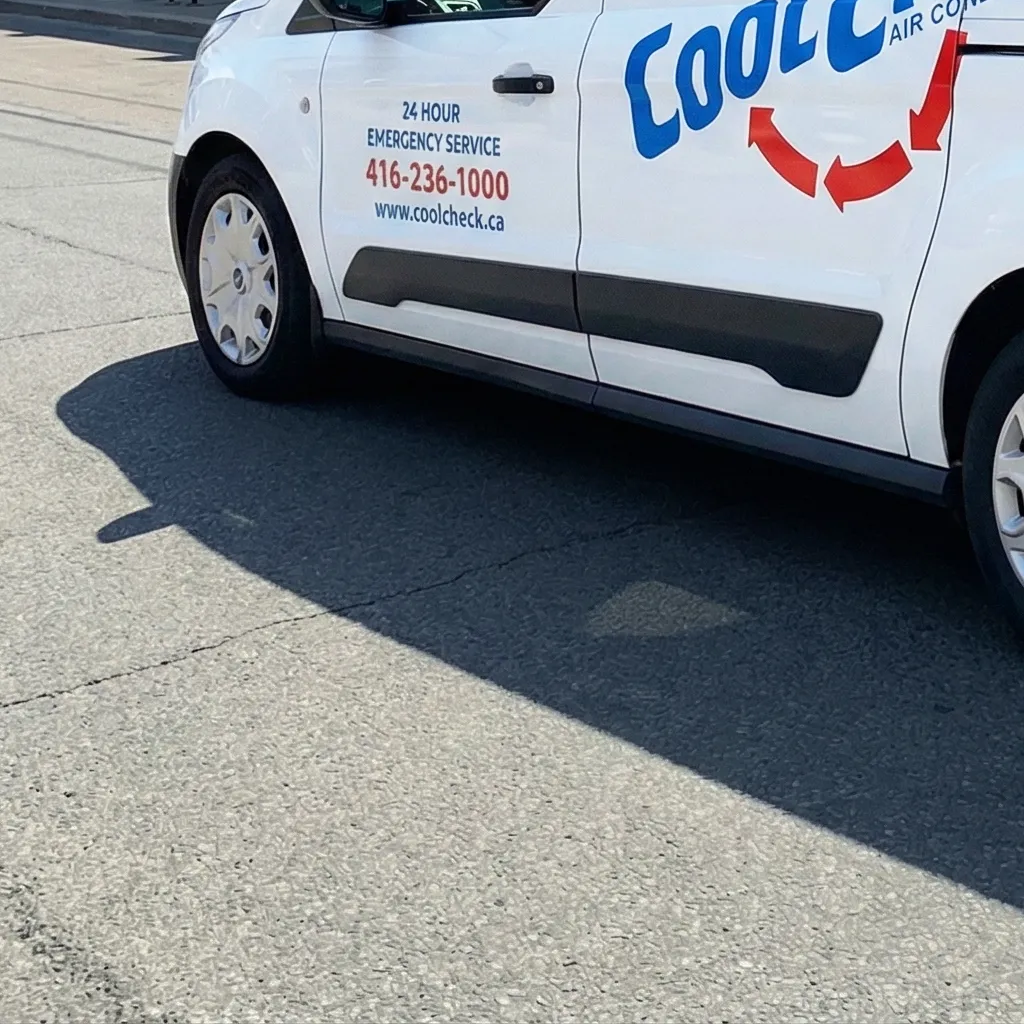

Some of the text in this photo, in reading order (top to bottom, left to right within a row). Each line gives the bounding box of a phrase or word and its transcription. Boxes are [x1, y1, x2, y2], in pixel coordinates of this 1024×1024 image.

[889, 12, 923, 45] AIR
[402, 101, 460, 123] 24 HOUR
[367, 128, 501, 157] EMERGENCY SERVICE
[366, 158, 509, 200] 416-236-1000
[374, 202, 505, 231] www.coolcheck.ca
